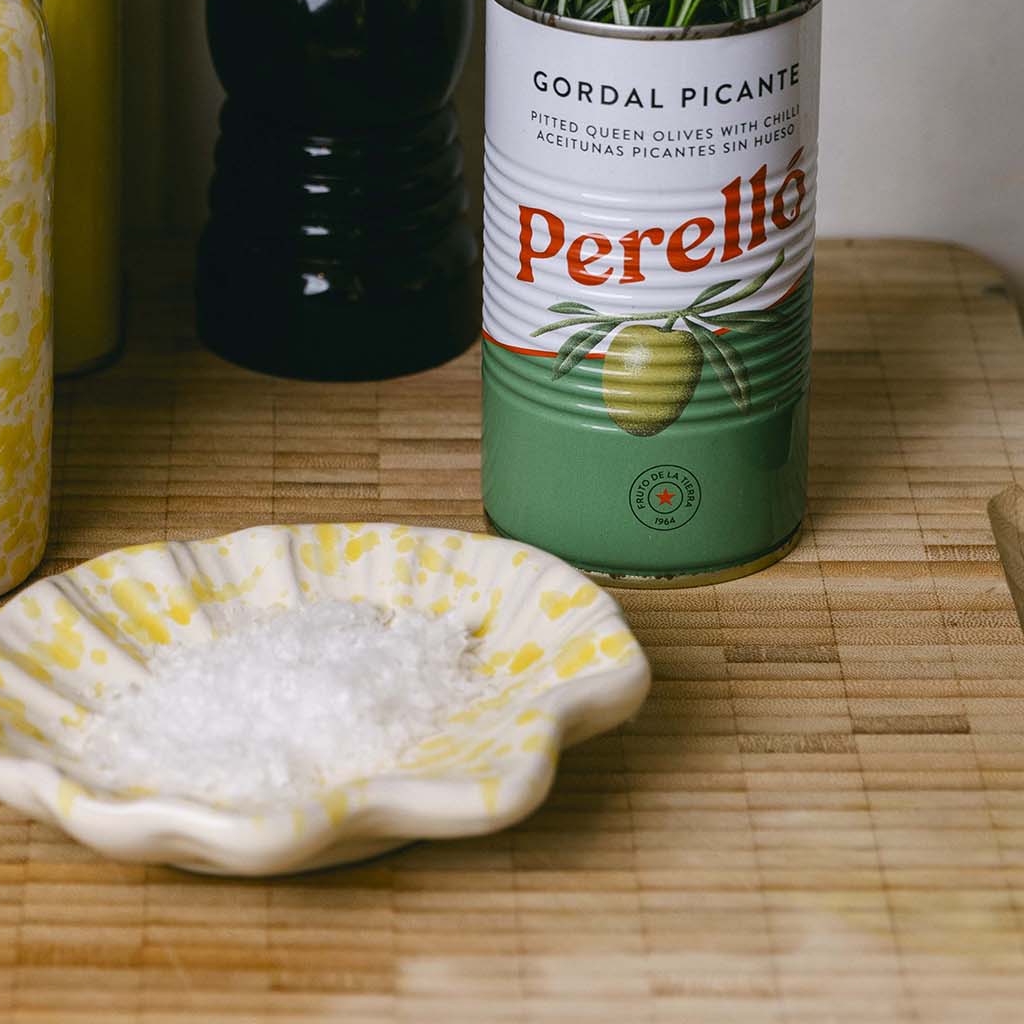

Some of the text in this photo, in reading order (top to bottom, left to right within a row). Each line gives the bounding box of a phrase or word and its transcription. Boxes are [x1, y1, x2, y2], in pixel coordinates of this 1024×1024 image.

[533, 63, 800, 109] GORDAL PICANTE
[530, 104, 801, 142] PITTED QUEEN OLIVES WITH CHILLI
[536, 123, 795, 159] ACEITUNAS PICANTES SIN HUESO
[516, 145, 807, 287] Perelló
[636, 470, 695, 510] FRUTO DE LA TIERRA
[654, 517, 676, 526] 1964
